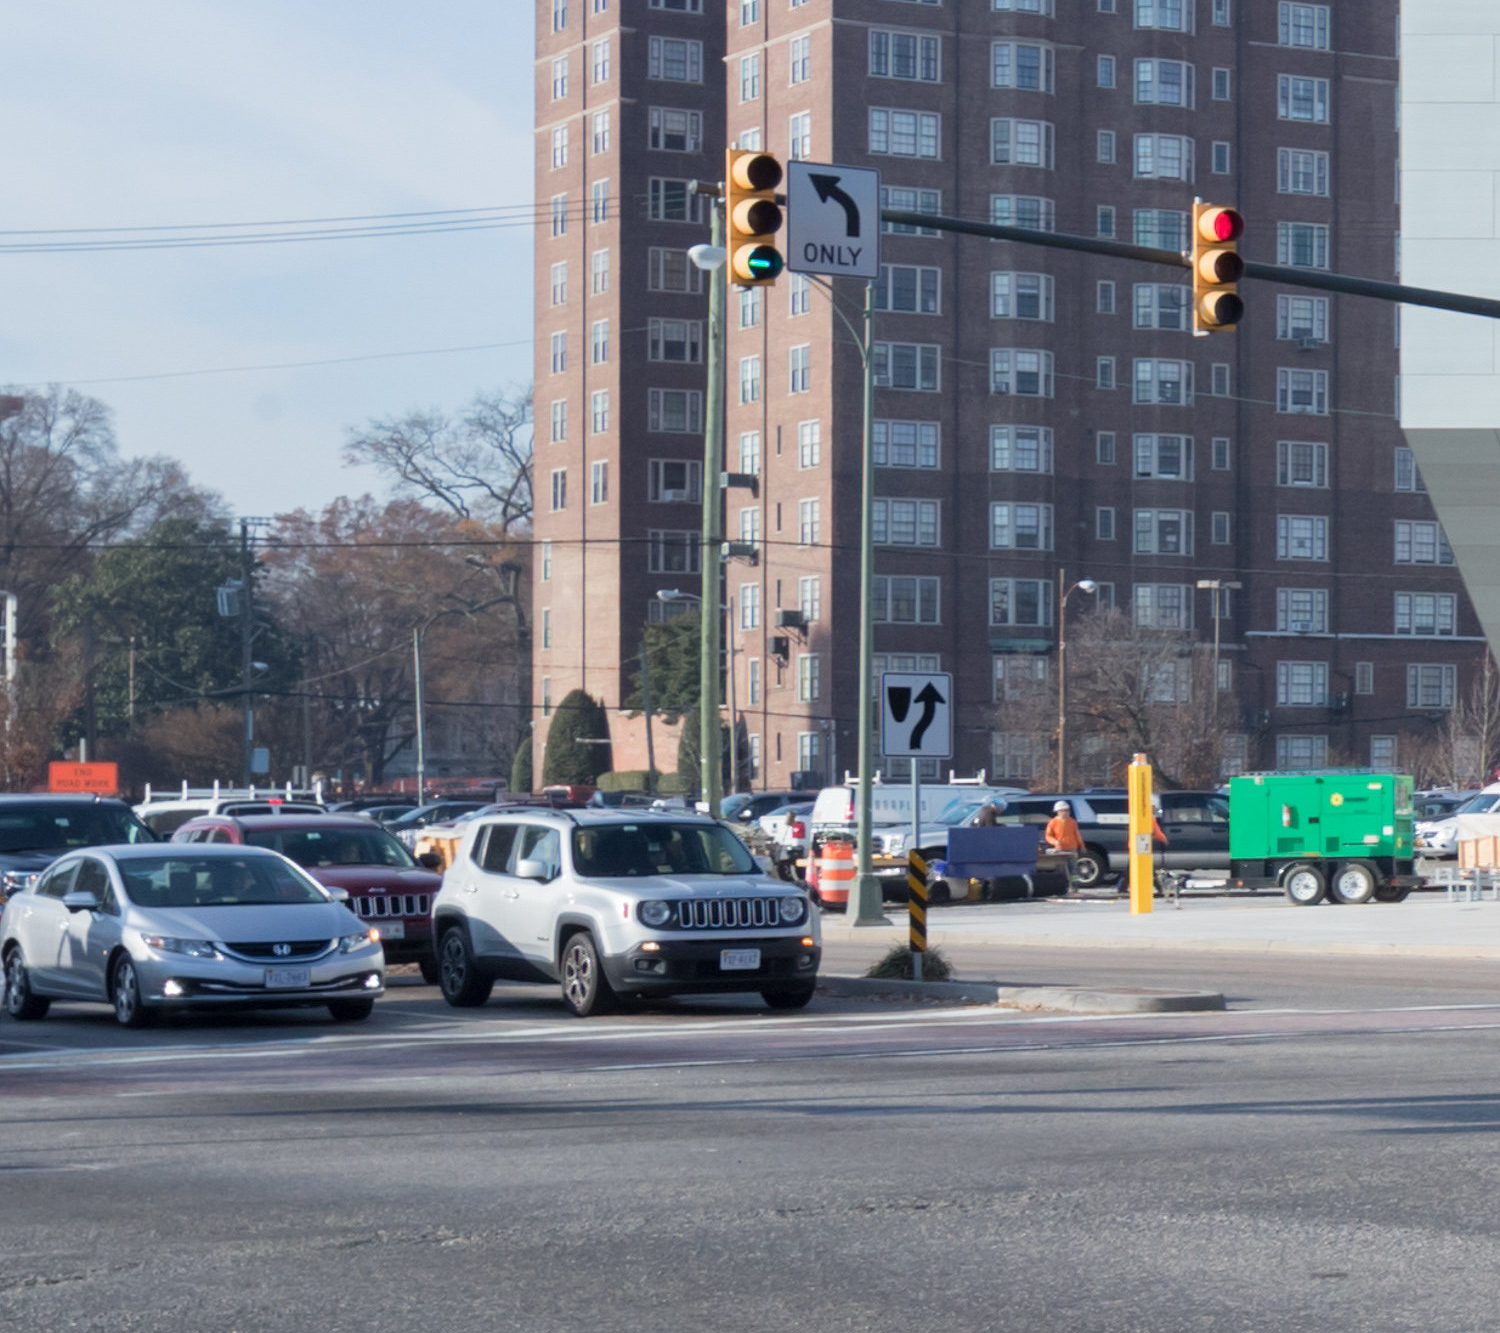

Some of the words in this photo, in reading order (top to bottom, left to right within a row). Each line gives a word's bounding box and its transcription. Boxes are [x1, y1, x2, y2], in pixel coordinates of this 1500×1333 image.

[804, 242, 863, 267] ONLY
[74, 768, 92, 777] END
[55, 779, 80, 787] ROAD
[84, 779, 109, 787] WORK
